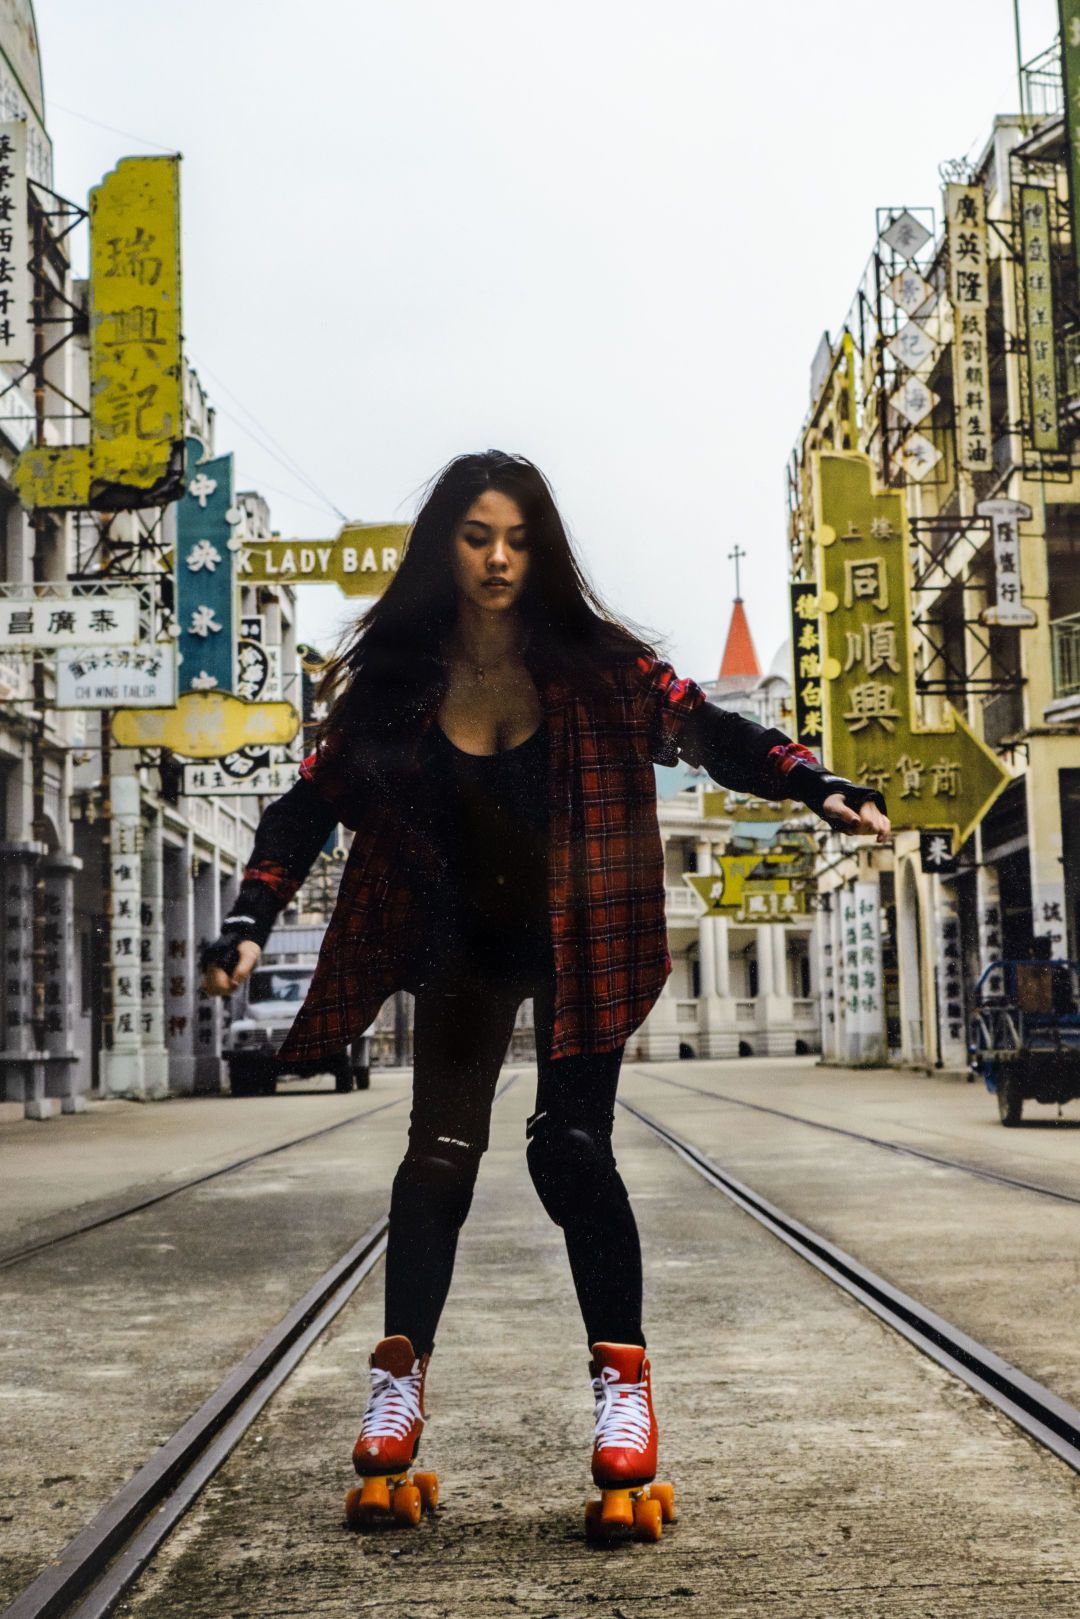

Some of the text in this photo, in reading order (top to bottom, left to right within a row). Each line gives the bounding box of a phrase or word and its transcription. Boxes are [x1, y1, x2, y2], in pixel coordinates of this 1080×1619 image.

[104, 227, 173, 441] 瑞興記
[265, 547, 332, 574] LADY
[343, 547, 399, 573] BAR
[95, 685, 118, 698] WING
[123, 684, 156, 698] TAILOR
[843, 556, 902, 734] 同順興
